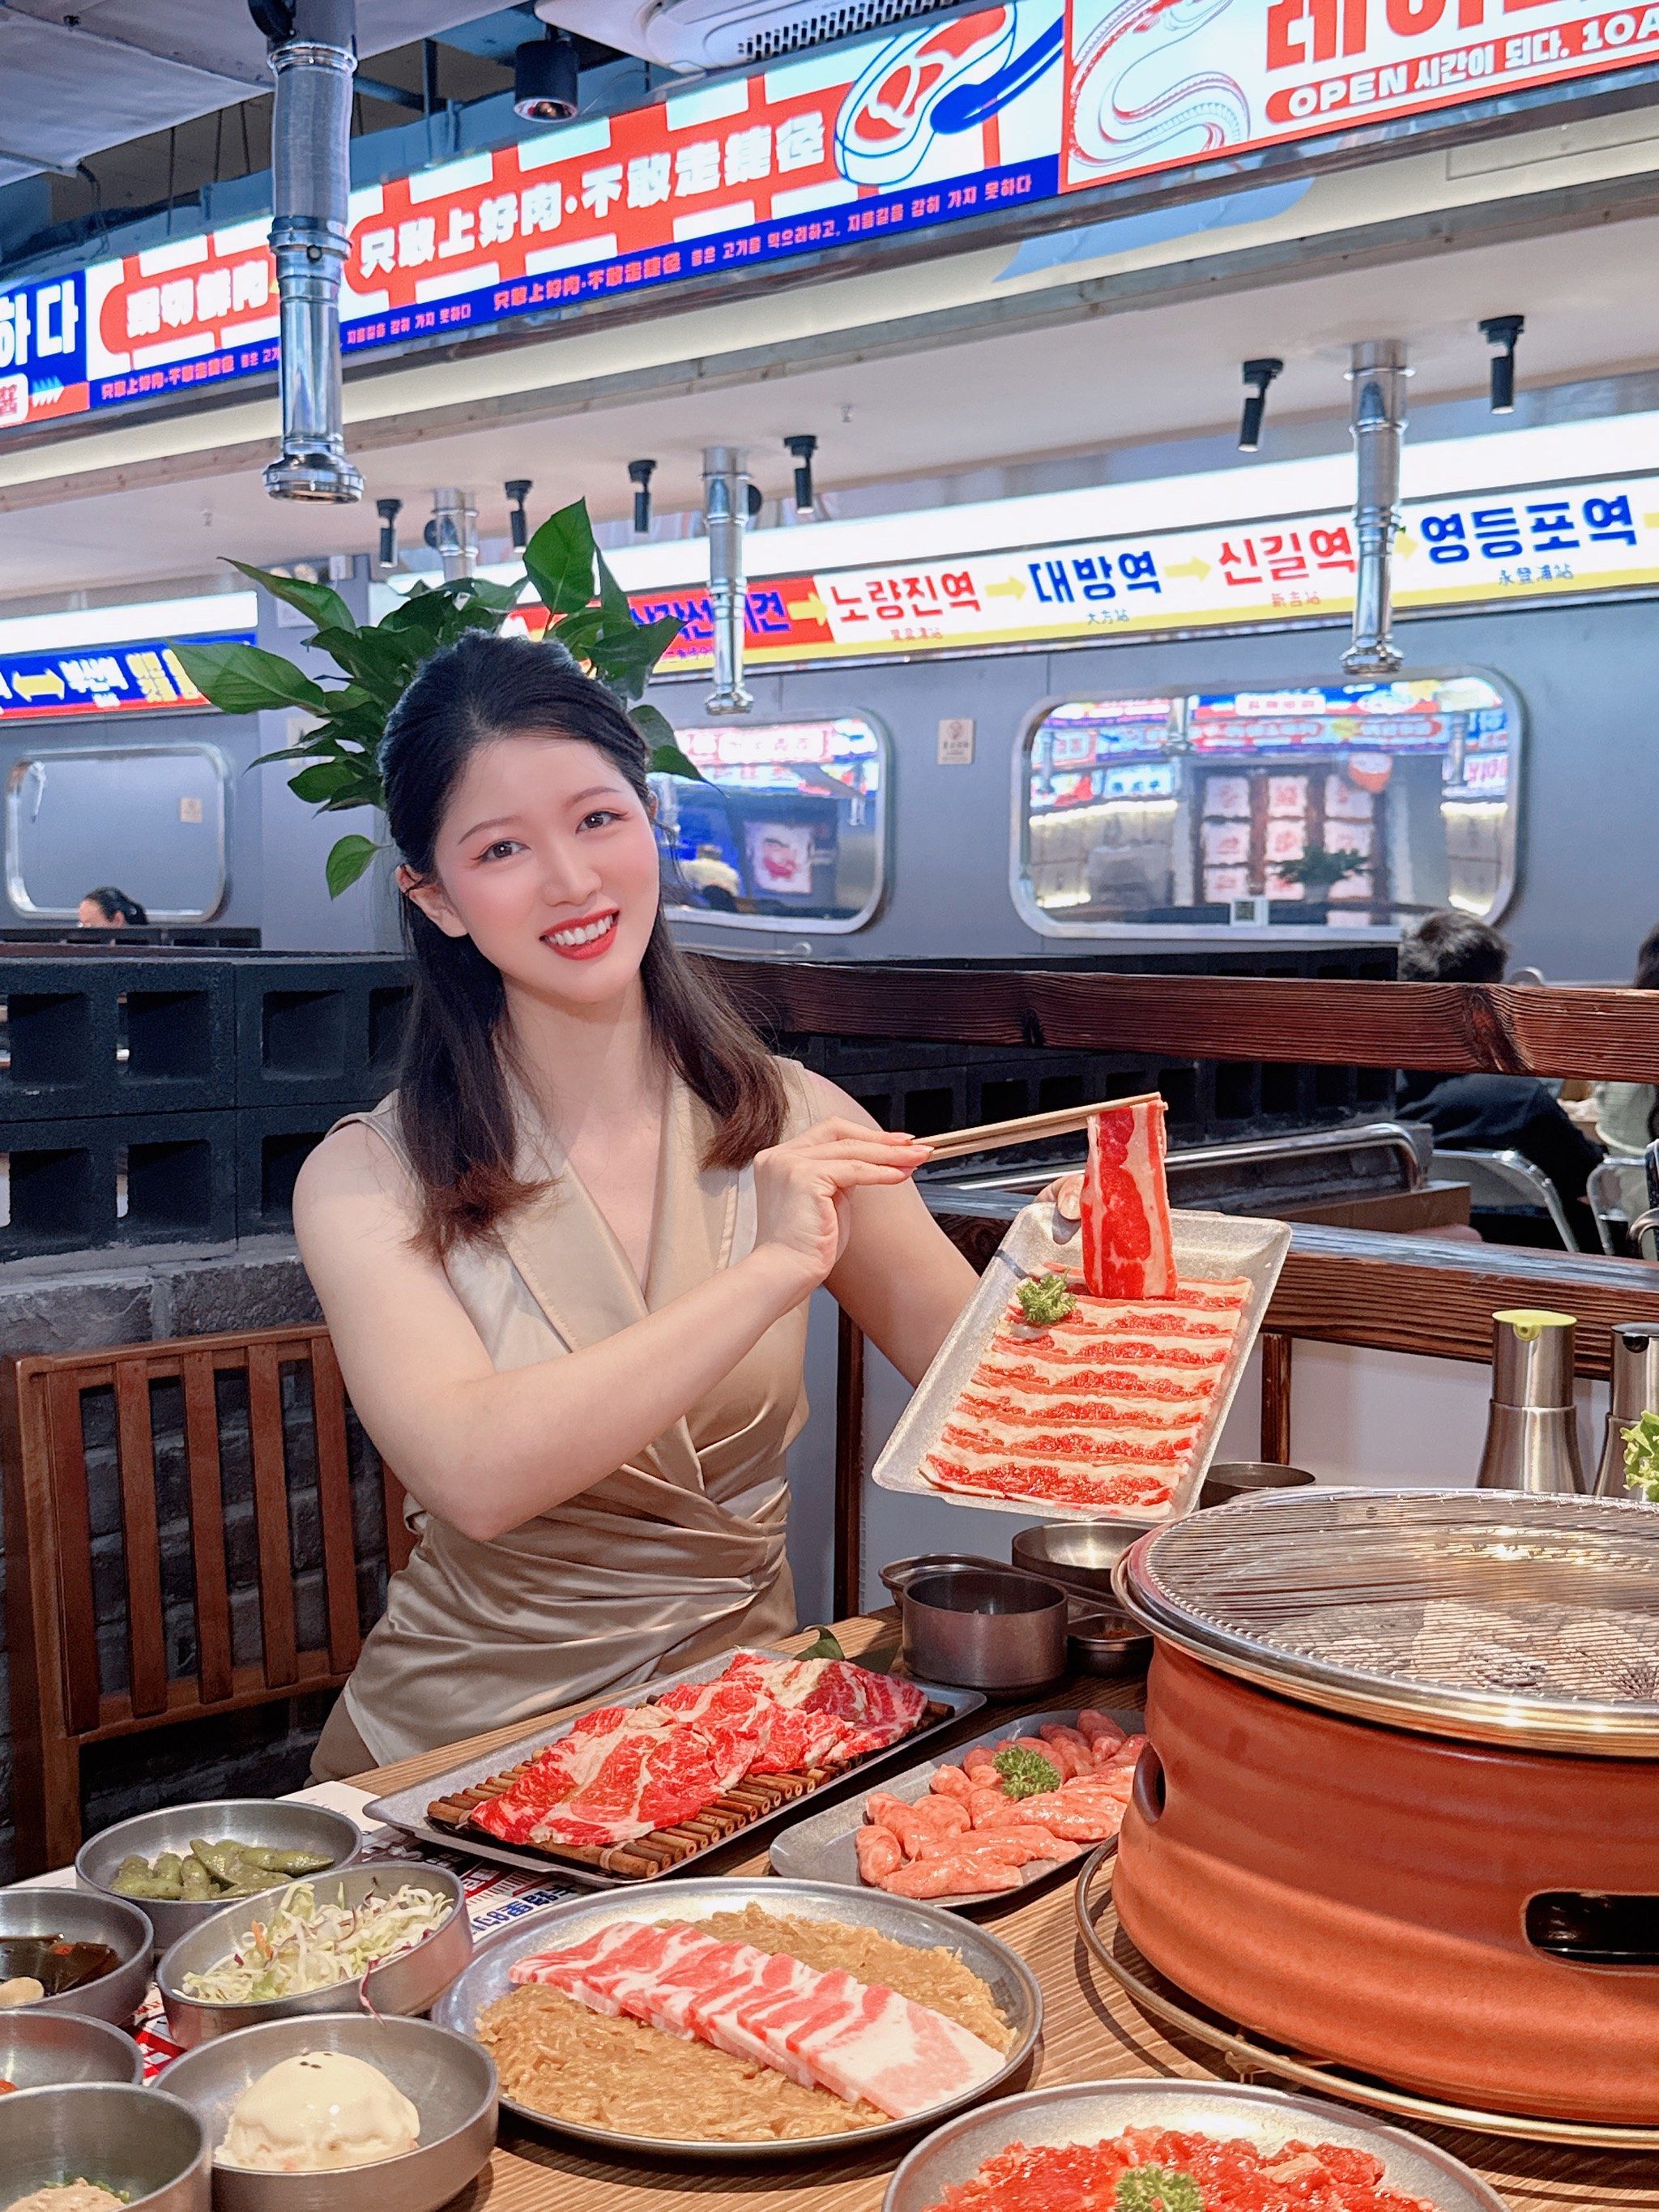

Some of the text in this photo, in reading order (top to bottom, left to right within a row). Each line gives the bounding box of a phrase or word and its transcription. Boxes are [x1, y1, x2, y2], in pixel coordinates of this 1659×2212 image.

[1289, 66, 1407, 117] OPEN
[1414, 44, 1495, 91] 시간이
[1505, 29, 1570, 70] 되다.
[830, 570, 981, 623] 노량진역
[1027, 550, 1162, 604] 대방역
[1218, 527, 1357, 587] 신길역
[1420, 494, 1638, 564] 영등포역
